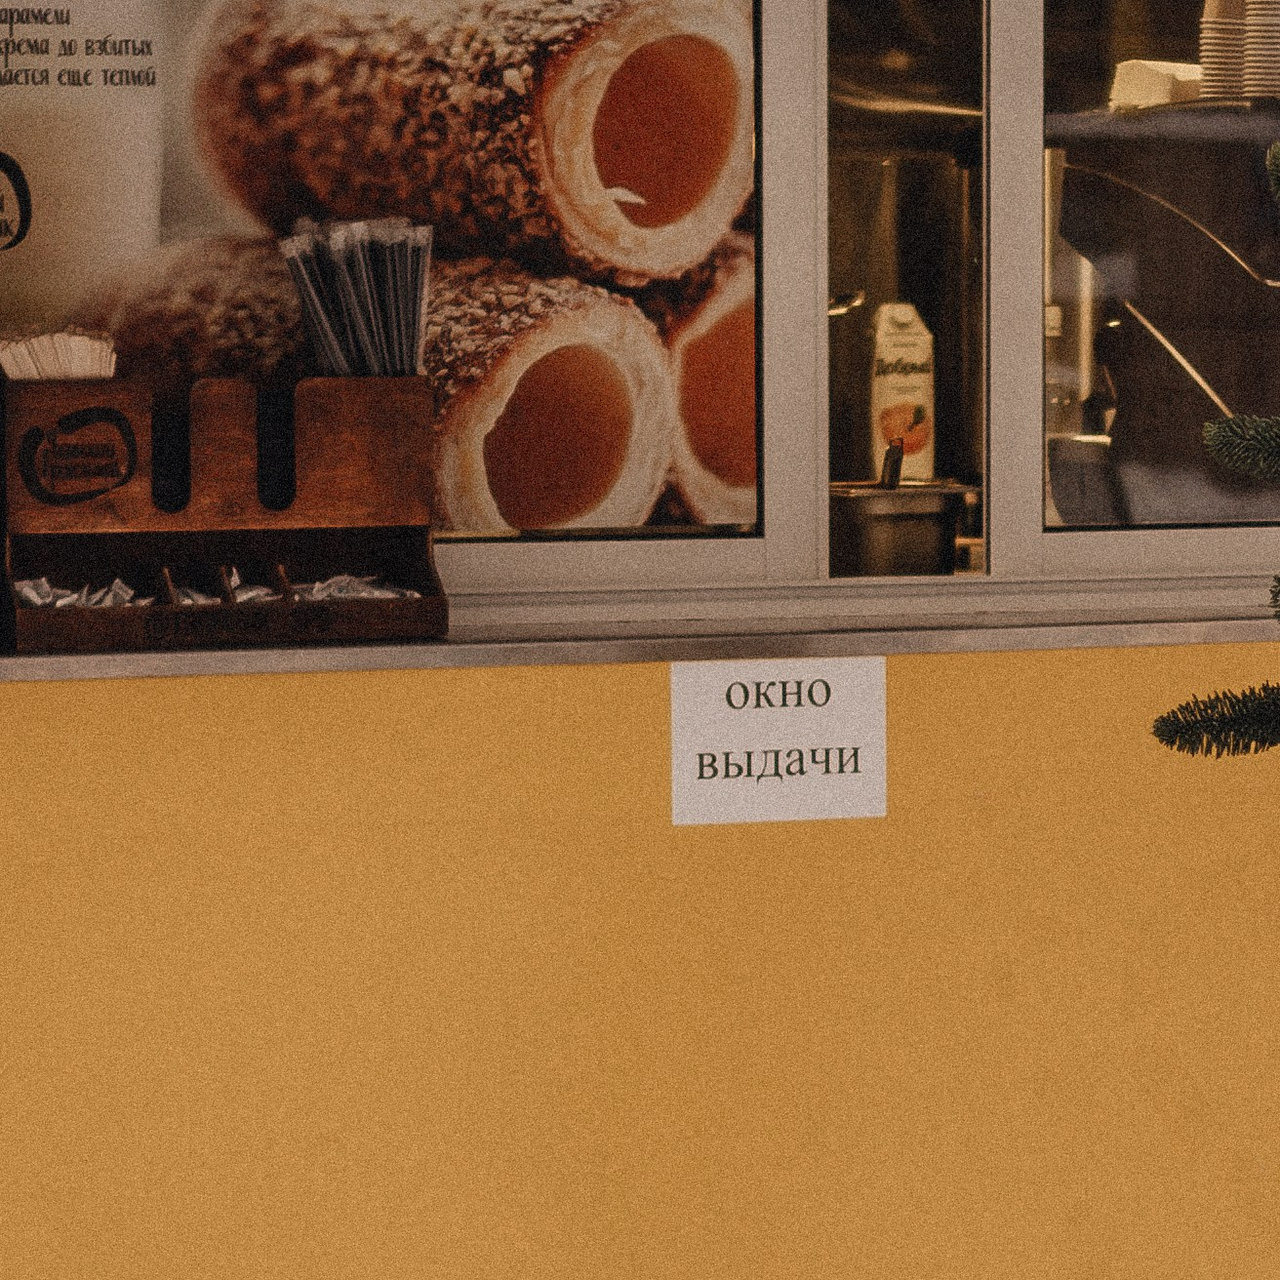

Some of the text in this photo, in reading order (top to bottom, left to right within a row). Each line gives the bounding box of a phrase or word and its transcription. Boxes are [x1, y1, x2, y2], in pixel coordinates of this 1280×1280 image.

[58, 39, 77, 57] до
[85, 34, 152, 56] взбитых
[57, 68, 93, 87] еще
[102, 66, 156, 86] теплой
[725, 678, 832, 710] окно
[696, 746, 863, 784] выдачи
